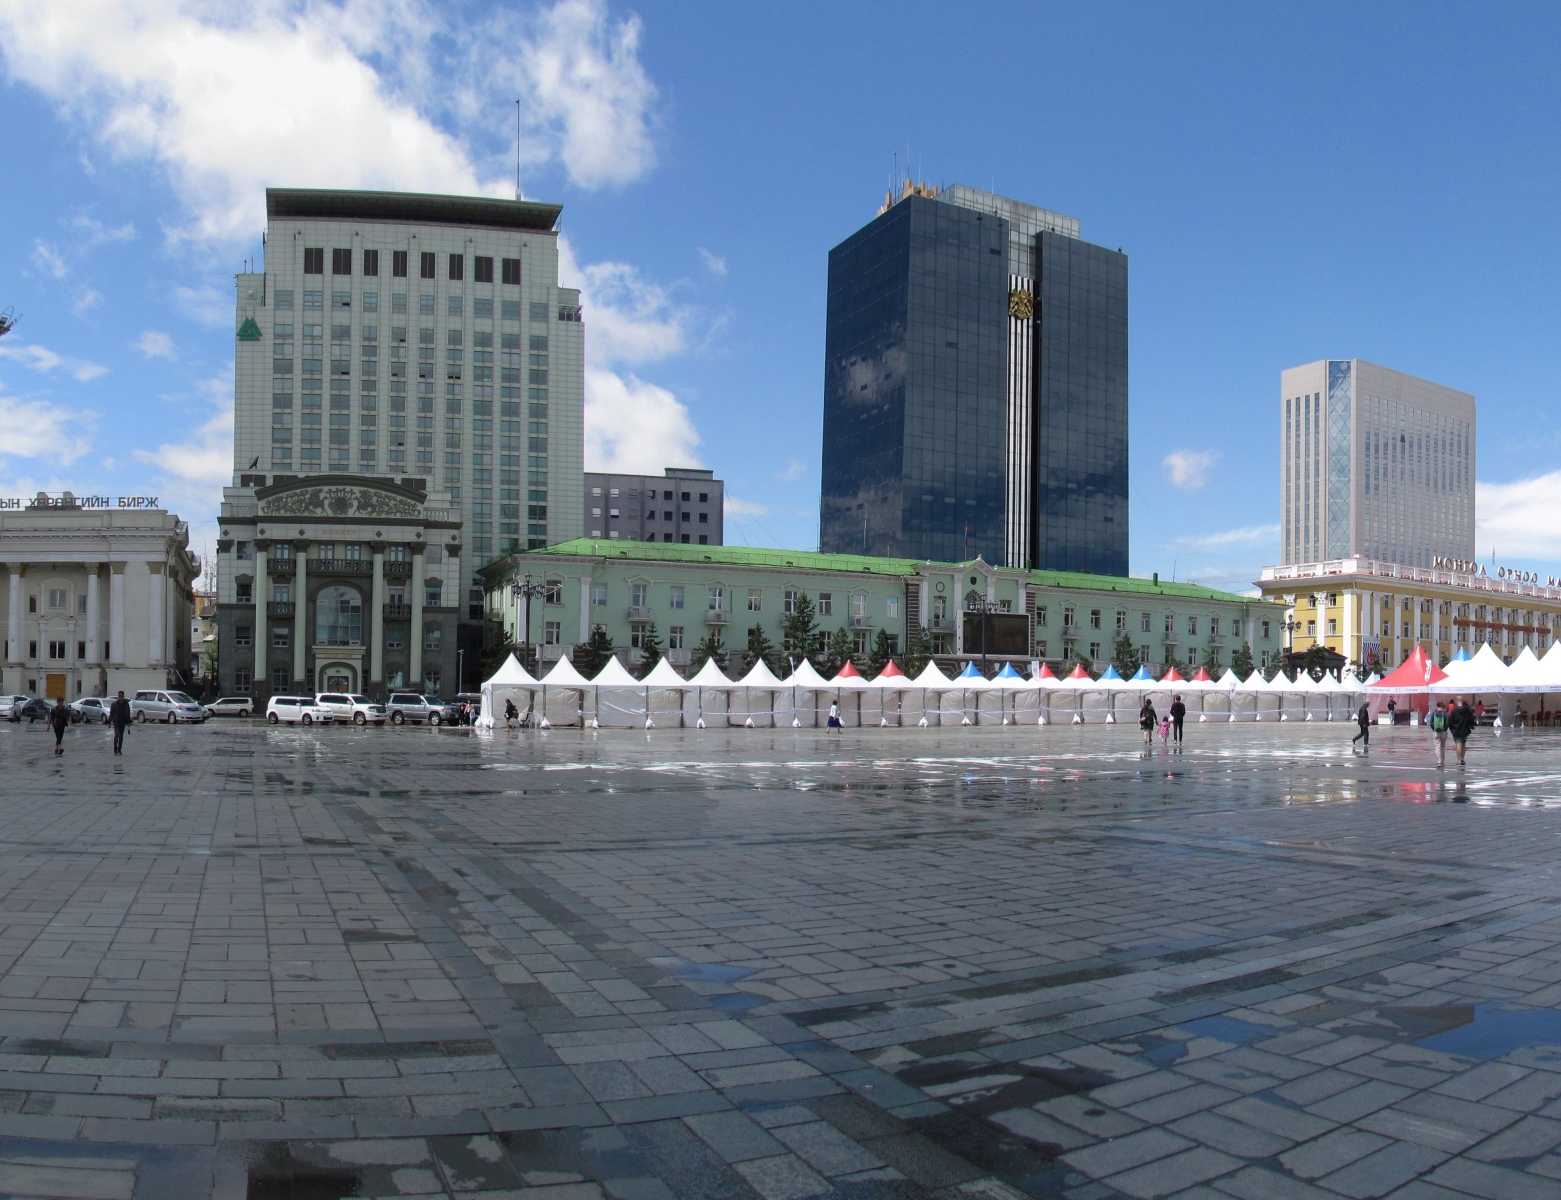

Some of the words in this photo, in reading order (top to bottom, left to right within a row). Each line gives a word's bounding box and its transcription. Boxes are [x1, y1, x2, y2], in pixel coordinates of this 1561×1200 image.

[118, 496, 159, 508] БИРЖ
[1432, 555, 1487, 576] МОНГОЛ
[1497, 566, 1538, 584] ОРНОО
